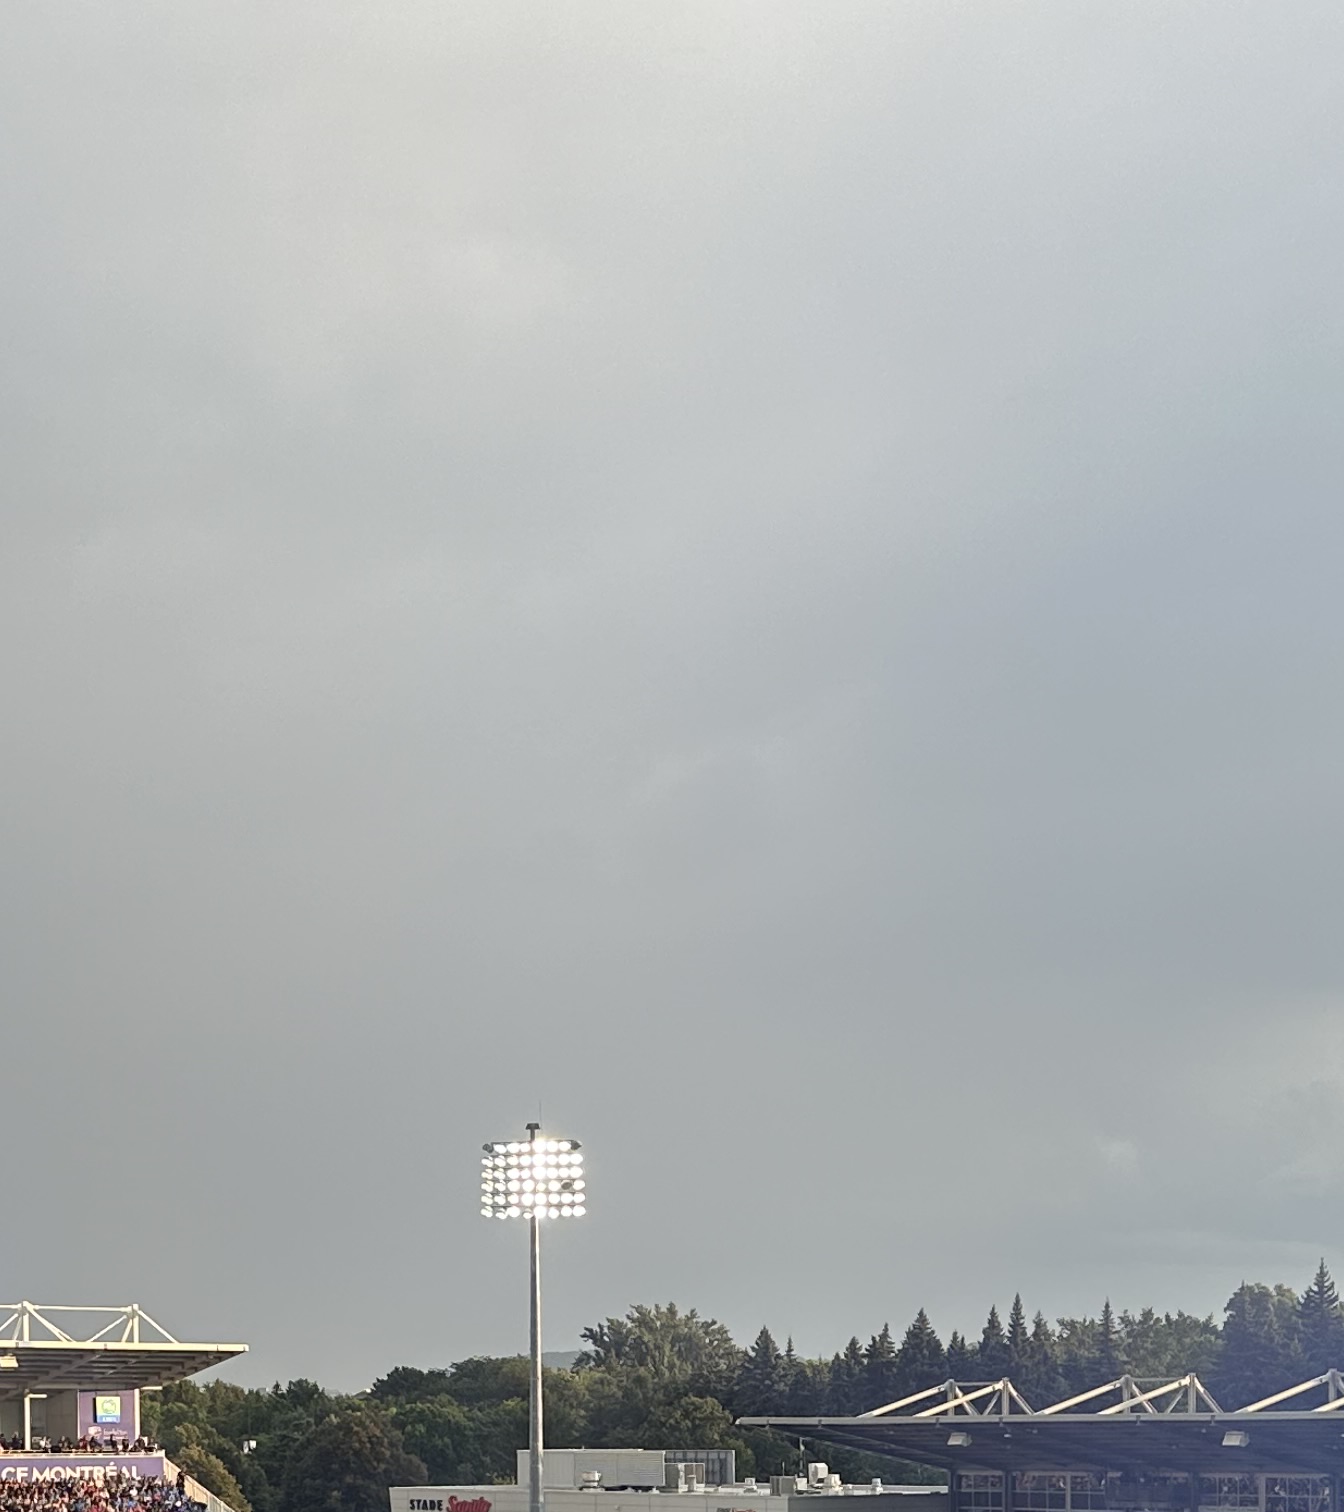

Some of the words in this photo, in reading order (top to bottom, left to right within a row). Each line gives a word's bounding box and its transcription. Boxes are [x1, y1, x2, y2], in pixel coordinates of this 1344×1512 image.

[1, 1465, 28, 1482] CF
[32, 1461, 142, 1482] MONTRÉAL
[409, 1499, 443, 1511] STADE
